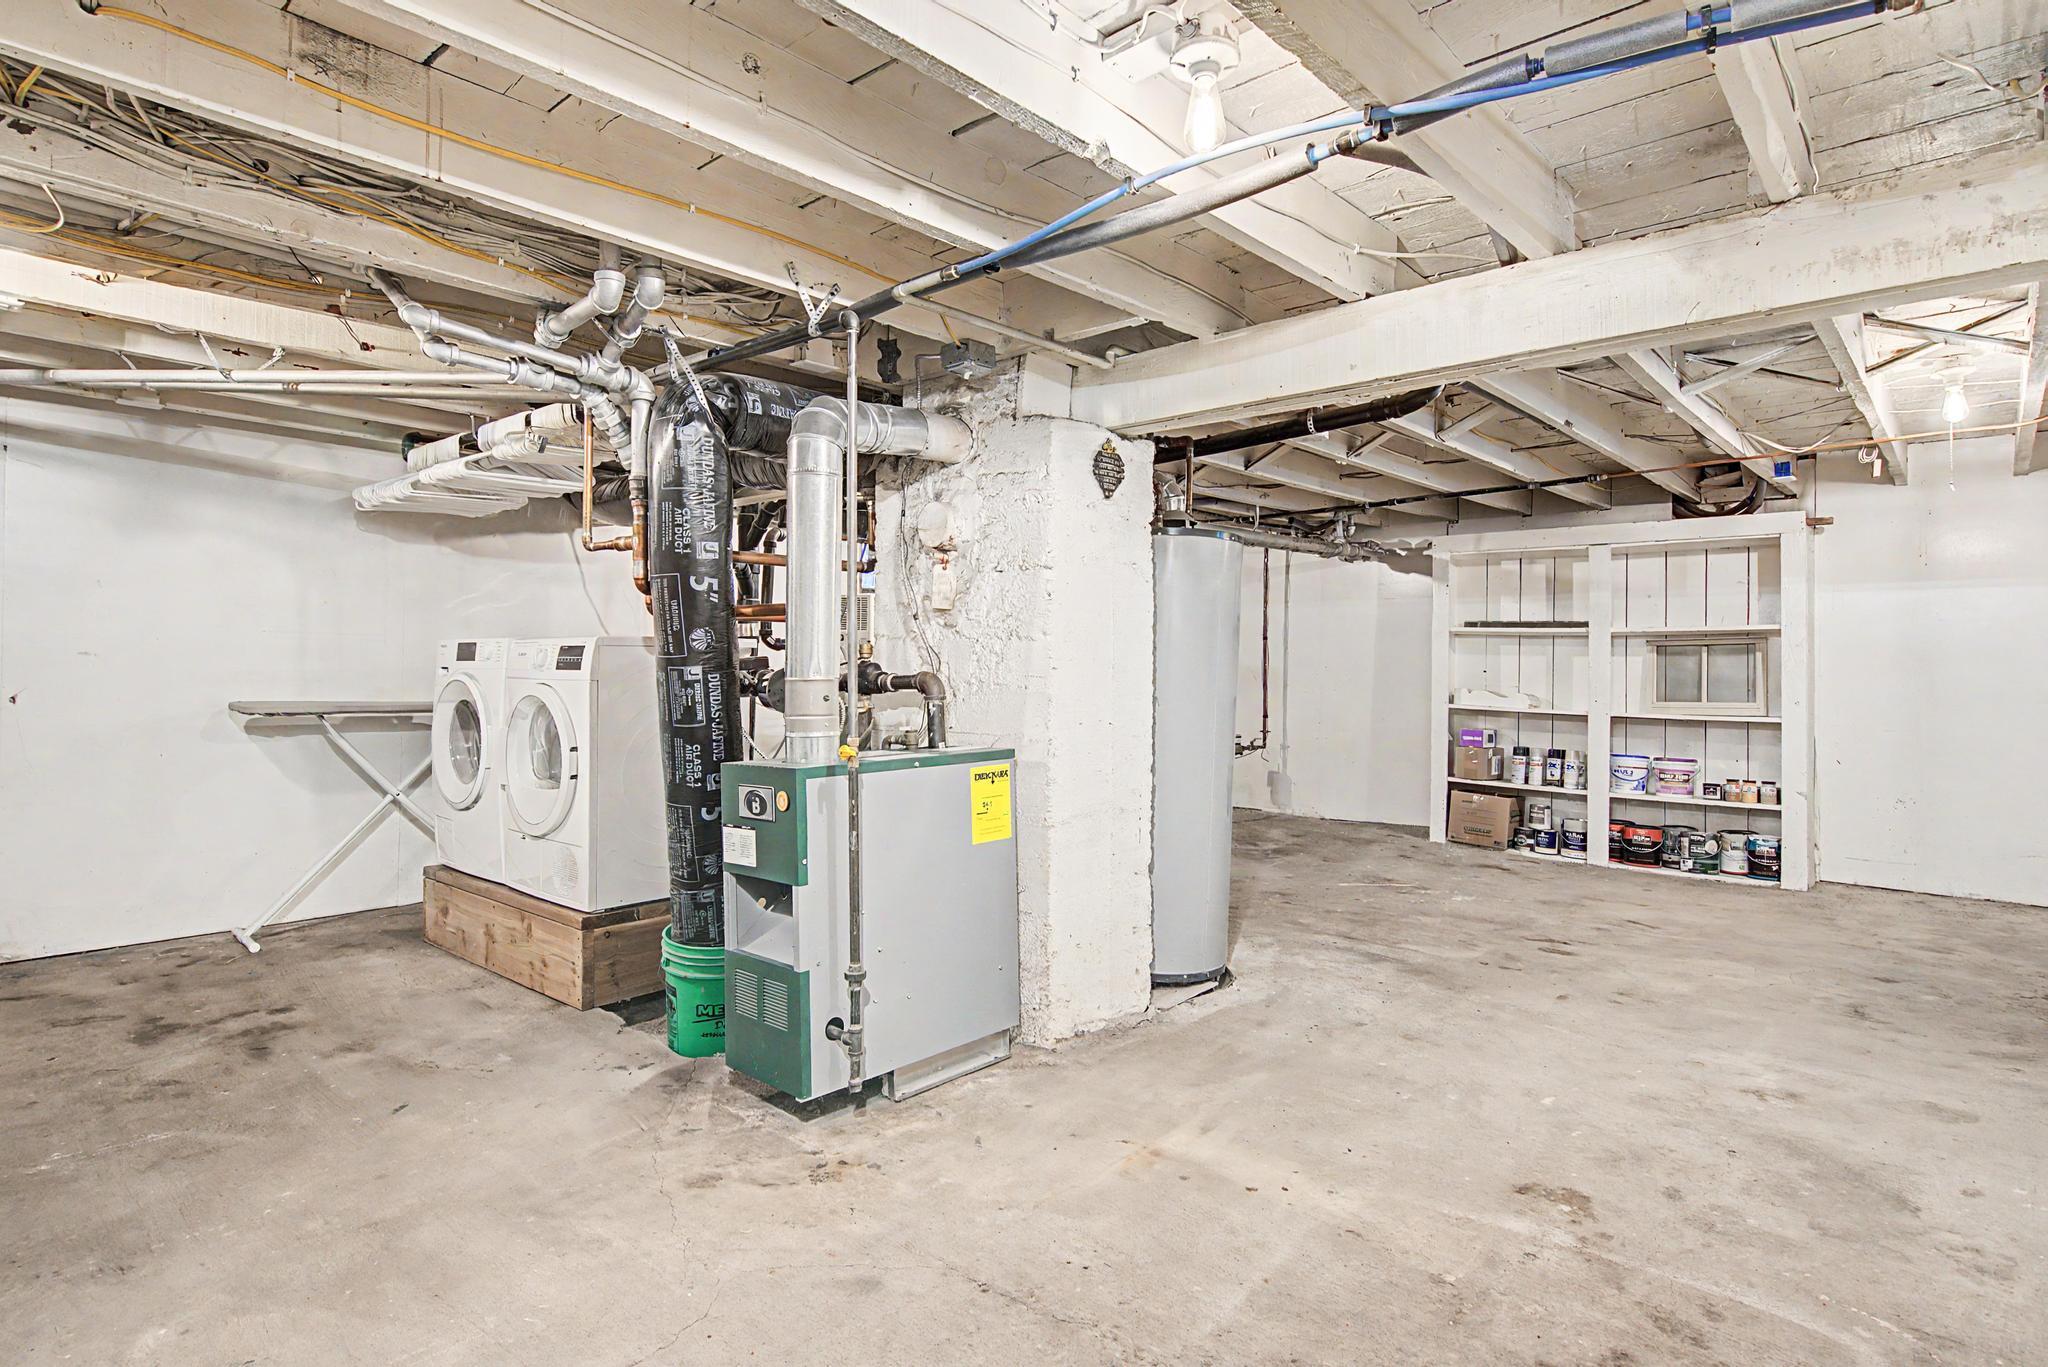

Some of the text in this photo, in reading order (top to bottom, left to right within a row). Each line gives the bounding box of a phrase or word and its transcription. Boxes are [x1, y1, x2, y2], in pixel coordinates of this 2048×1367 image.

[674, 507, 684, 555] AIR DUCT
[682, 508, 692, 545] CLASS
[684, 744, 695, 789] AIR DUCT
[693, 744, 702, 779] CLASS
